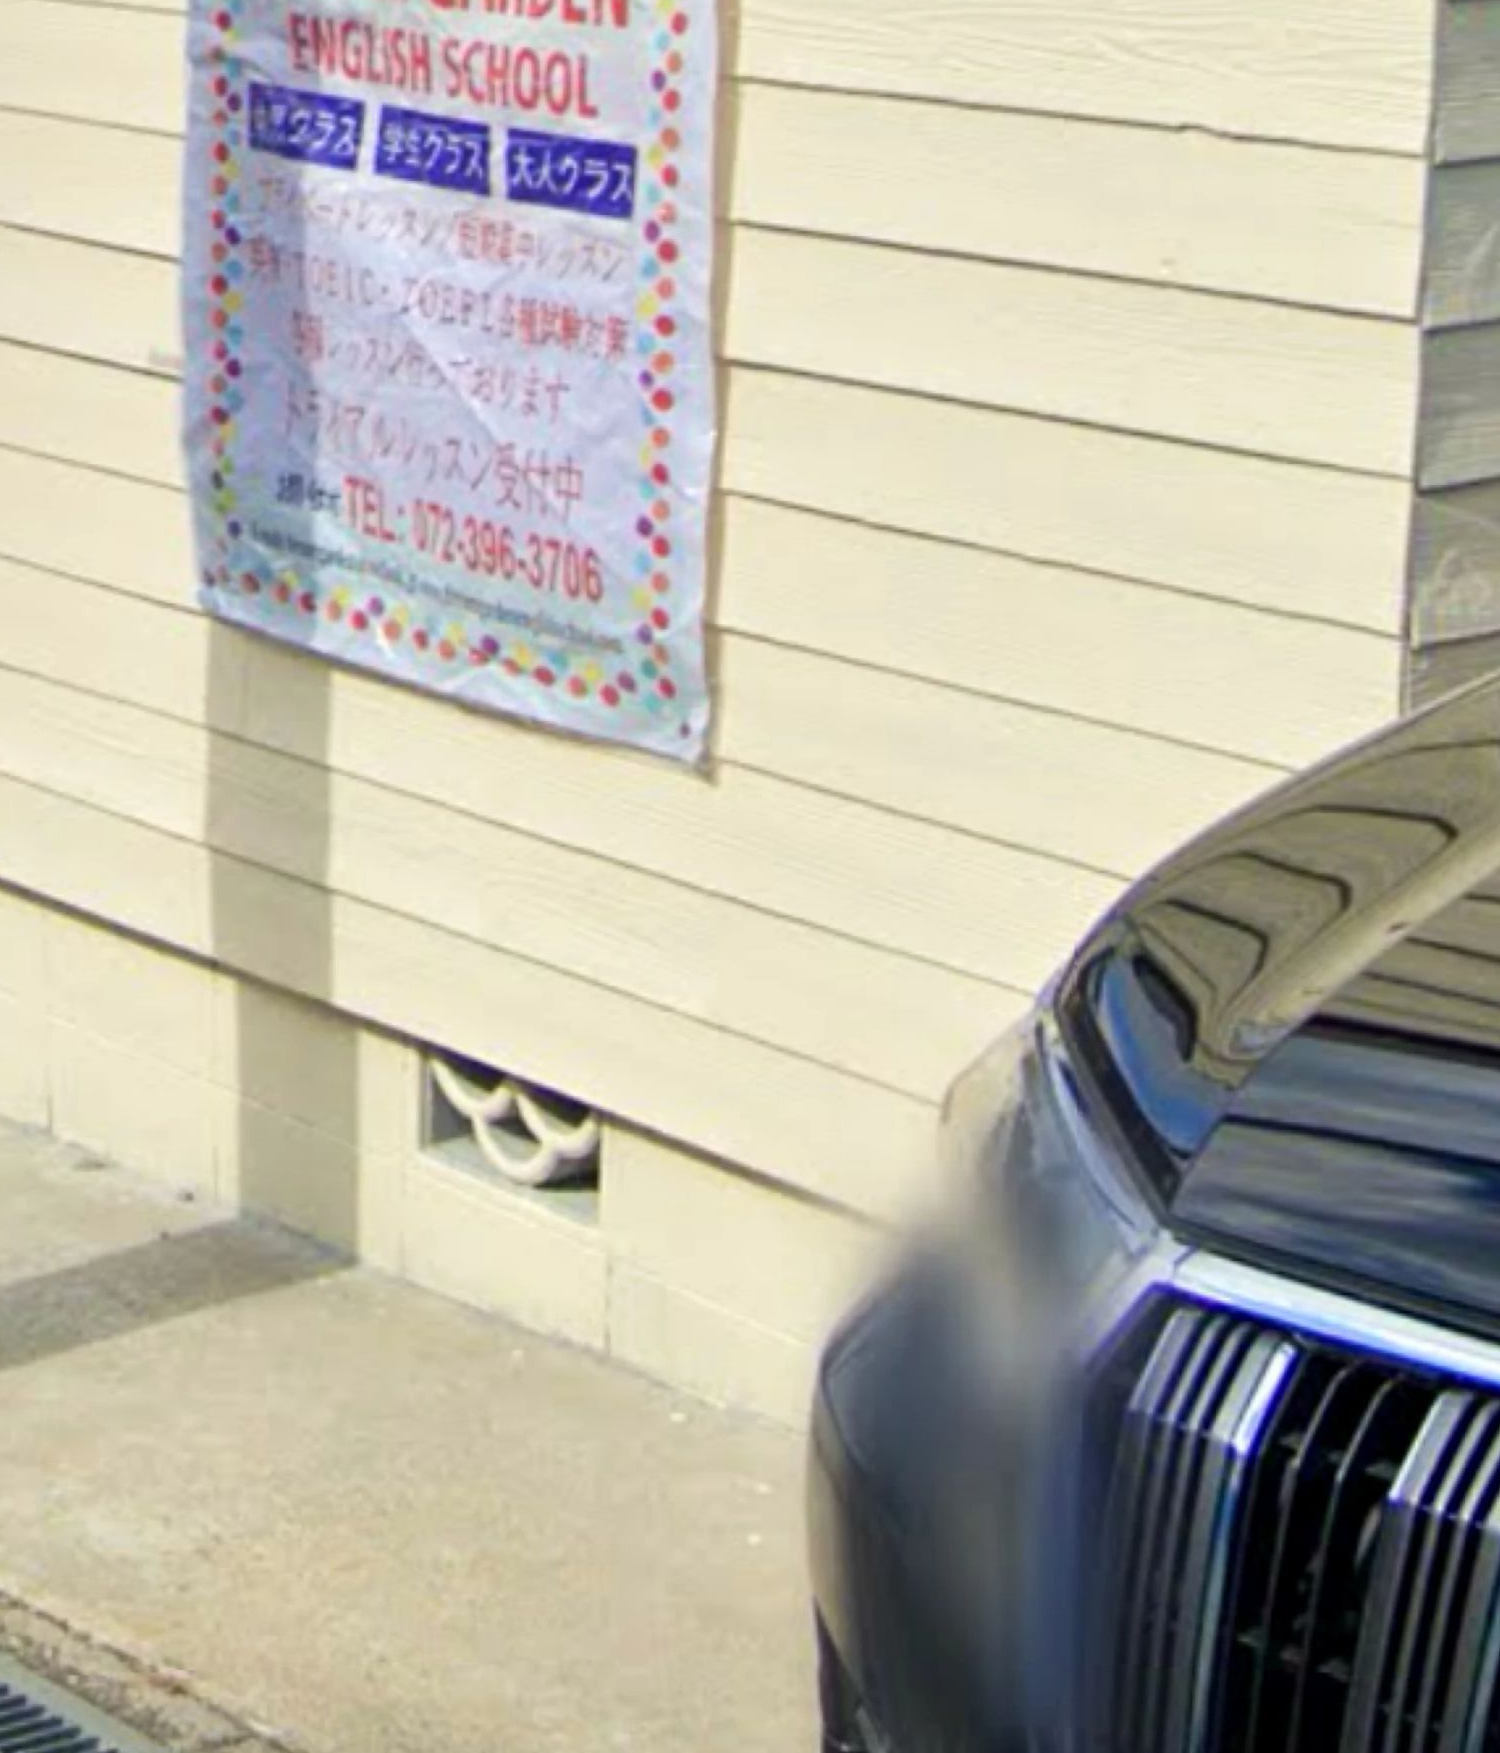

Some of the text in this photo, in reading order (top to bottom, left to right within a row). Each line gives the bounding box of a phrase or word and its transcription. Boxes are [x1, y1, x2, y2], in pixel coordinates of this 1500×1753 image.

[288, 11, 599, 119] ENGLISH SCHOOL
[253, 94, 357, 156] クラス
[510, 144, 633, 202] 大人クラス
[411, 498, 606, 602] 072-396-3706
